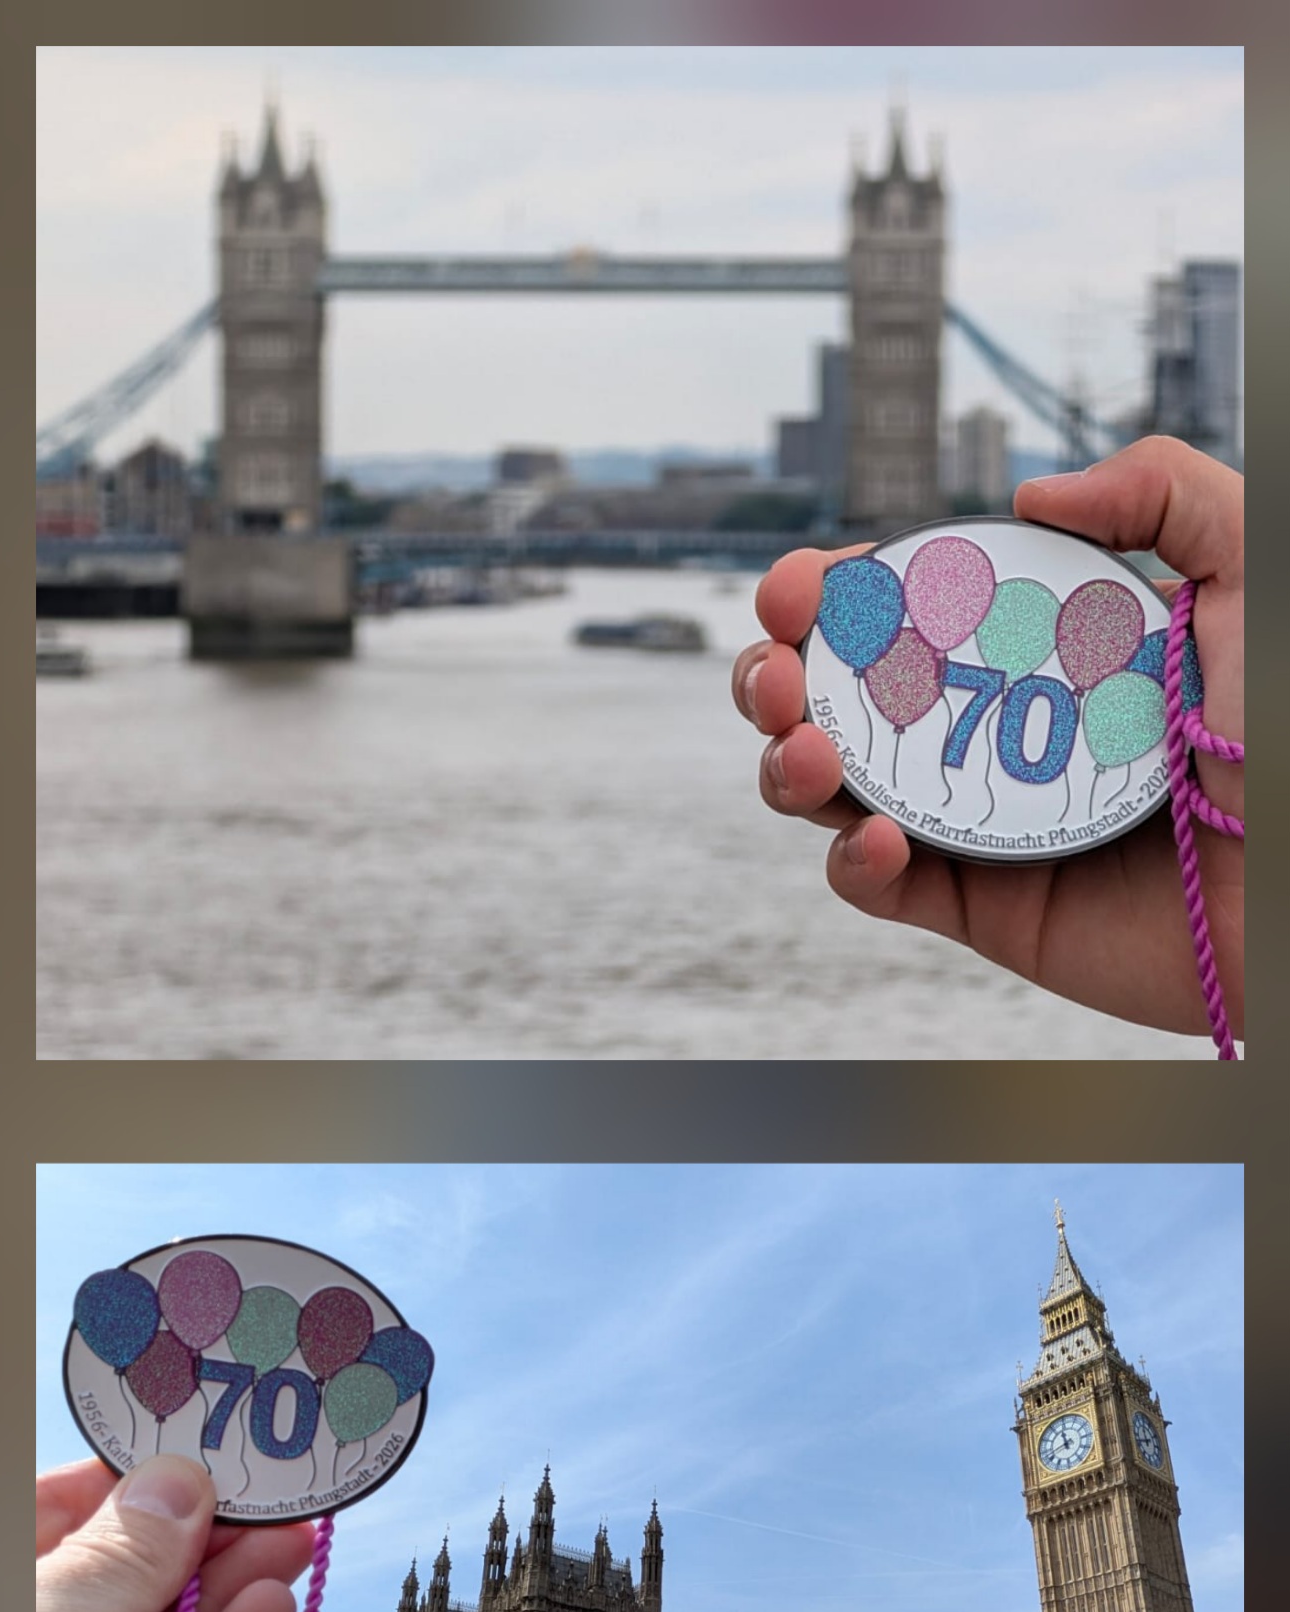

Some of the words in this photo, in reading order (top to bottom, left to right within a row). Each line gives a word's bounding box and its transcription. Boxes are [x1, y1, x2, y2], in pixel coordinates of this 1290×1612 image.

[941, 660, 1079, 785] 70
[839, 745, 918, 823] Katholische
[918, 812, 1045, 849] Pfarrfastnacht
[1048, 800, 1138, 847] Pfungstadt
[198, 1358, 322, 1460] 70
[102, 1435, 137, 1470] Kath
[215, 1499, 297, 1515] rfastnacht
[298, 1467, 374, 1510] Pfungstadt
[375, 1432, 405, 1469] 2026
